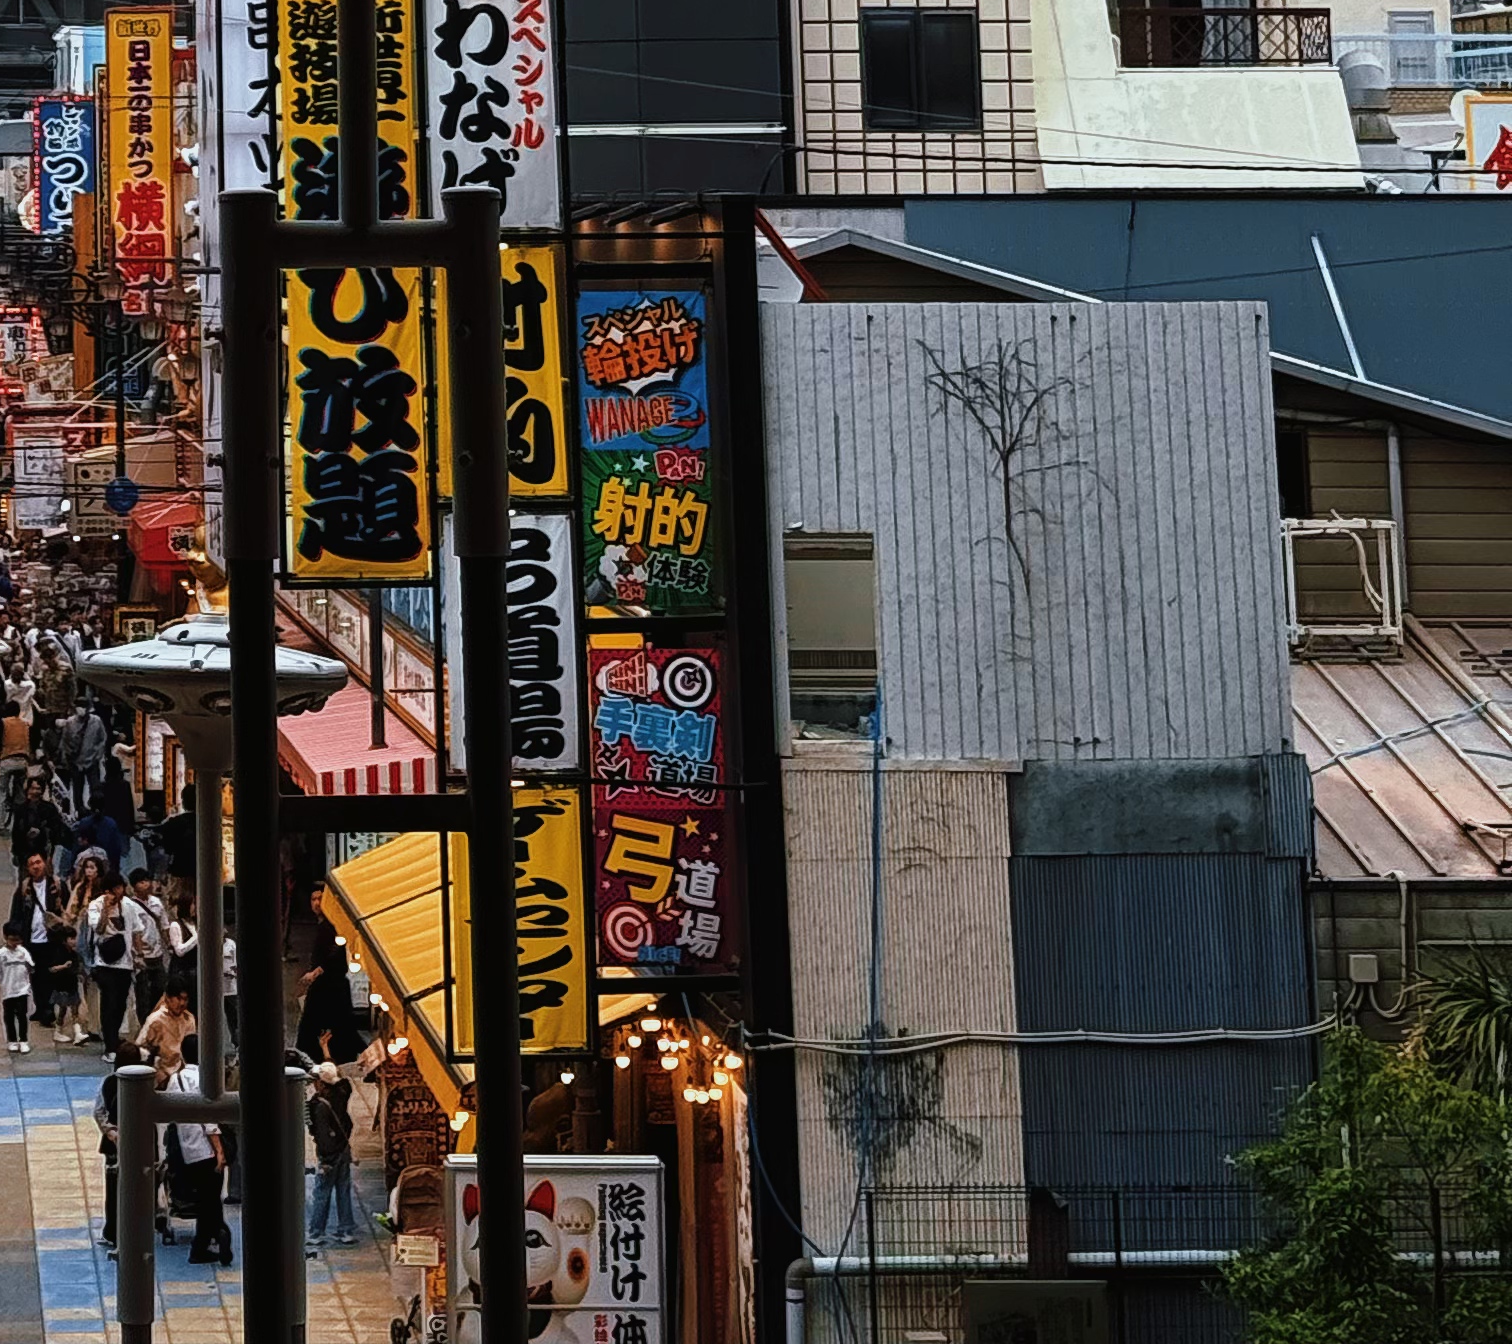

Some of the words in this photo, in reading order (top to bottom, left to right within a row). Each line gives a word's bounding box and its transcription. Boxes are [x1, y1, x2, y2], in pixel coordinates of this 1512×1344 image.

[584, 298, 684, 338] スペシャル
[583, 320, 698, 386] 輪投げ
[585, 396, 675, 445] WANAGE
[591, 475, 708, 556] 射的
[646, 552, 711, 594] 体験
[594, 696, 717, 762] 手裏剣
[604, 813, 675, 904] 弓
[674, 858, 721, 959] 道場
